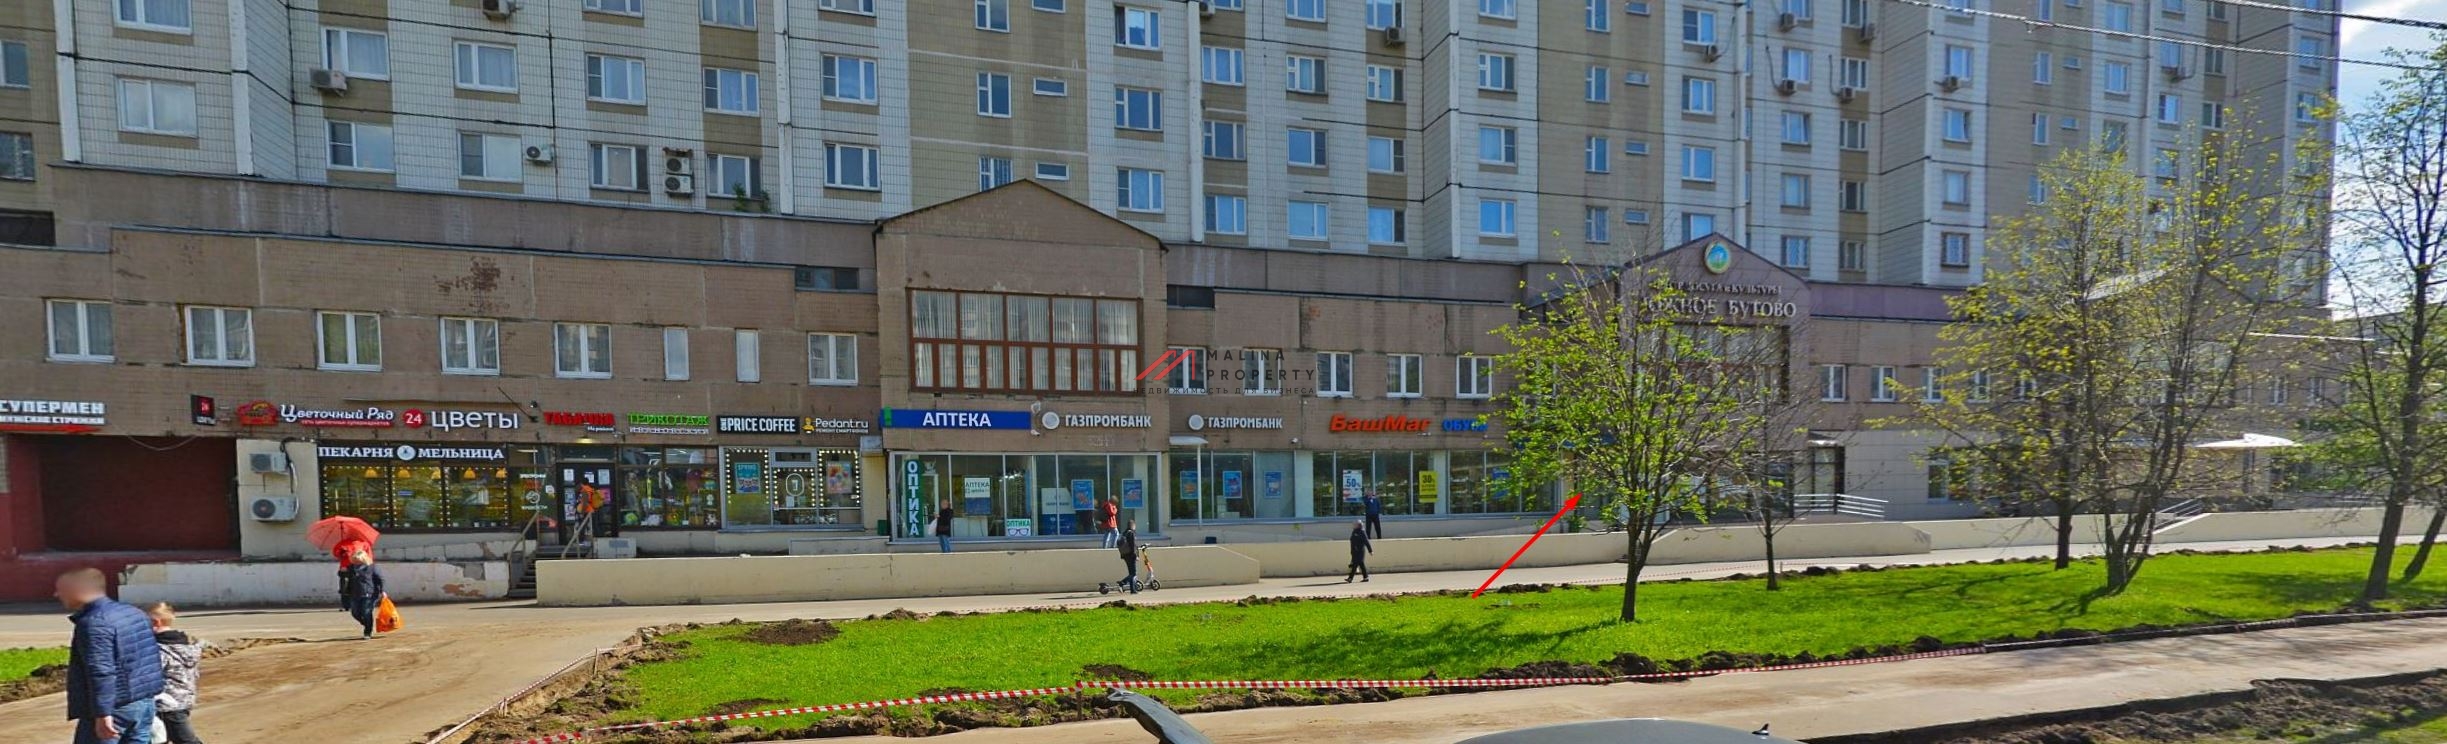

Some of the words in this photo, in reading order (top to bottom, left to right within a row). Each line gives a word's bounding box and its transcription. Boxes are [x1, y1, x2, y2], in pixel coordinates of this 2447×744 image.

[1728, 299, 1796, 318] БУТОВО
[280, 404, 364, 423] Цветочный
[366, 407, 394, 420] Ряд
[405, 413, 422, 424] 24
[922, 412, 992, 427] АПТЕКА
[728, 417, 758, 432] PRICE
[759, 418, 796, 432] COFFEE
[815, 417, 869, 428] Pedant.ru
[1065, 415, 1152, 427] ГАЗПРОМБАНК
[1208, 417, 1283, 429] ГАЗПРОМБАНК
[1329, 414, 1432, 432] БашМаг
[317, 446, 394, 458] ПЕКАРНЯ
[418, 448, 505, 460] МЕЛЬНИЦА
[907, 460, 920, 536] ОПТИКА
